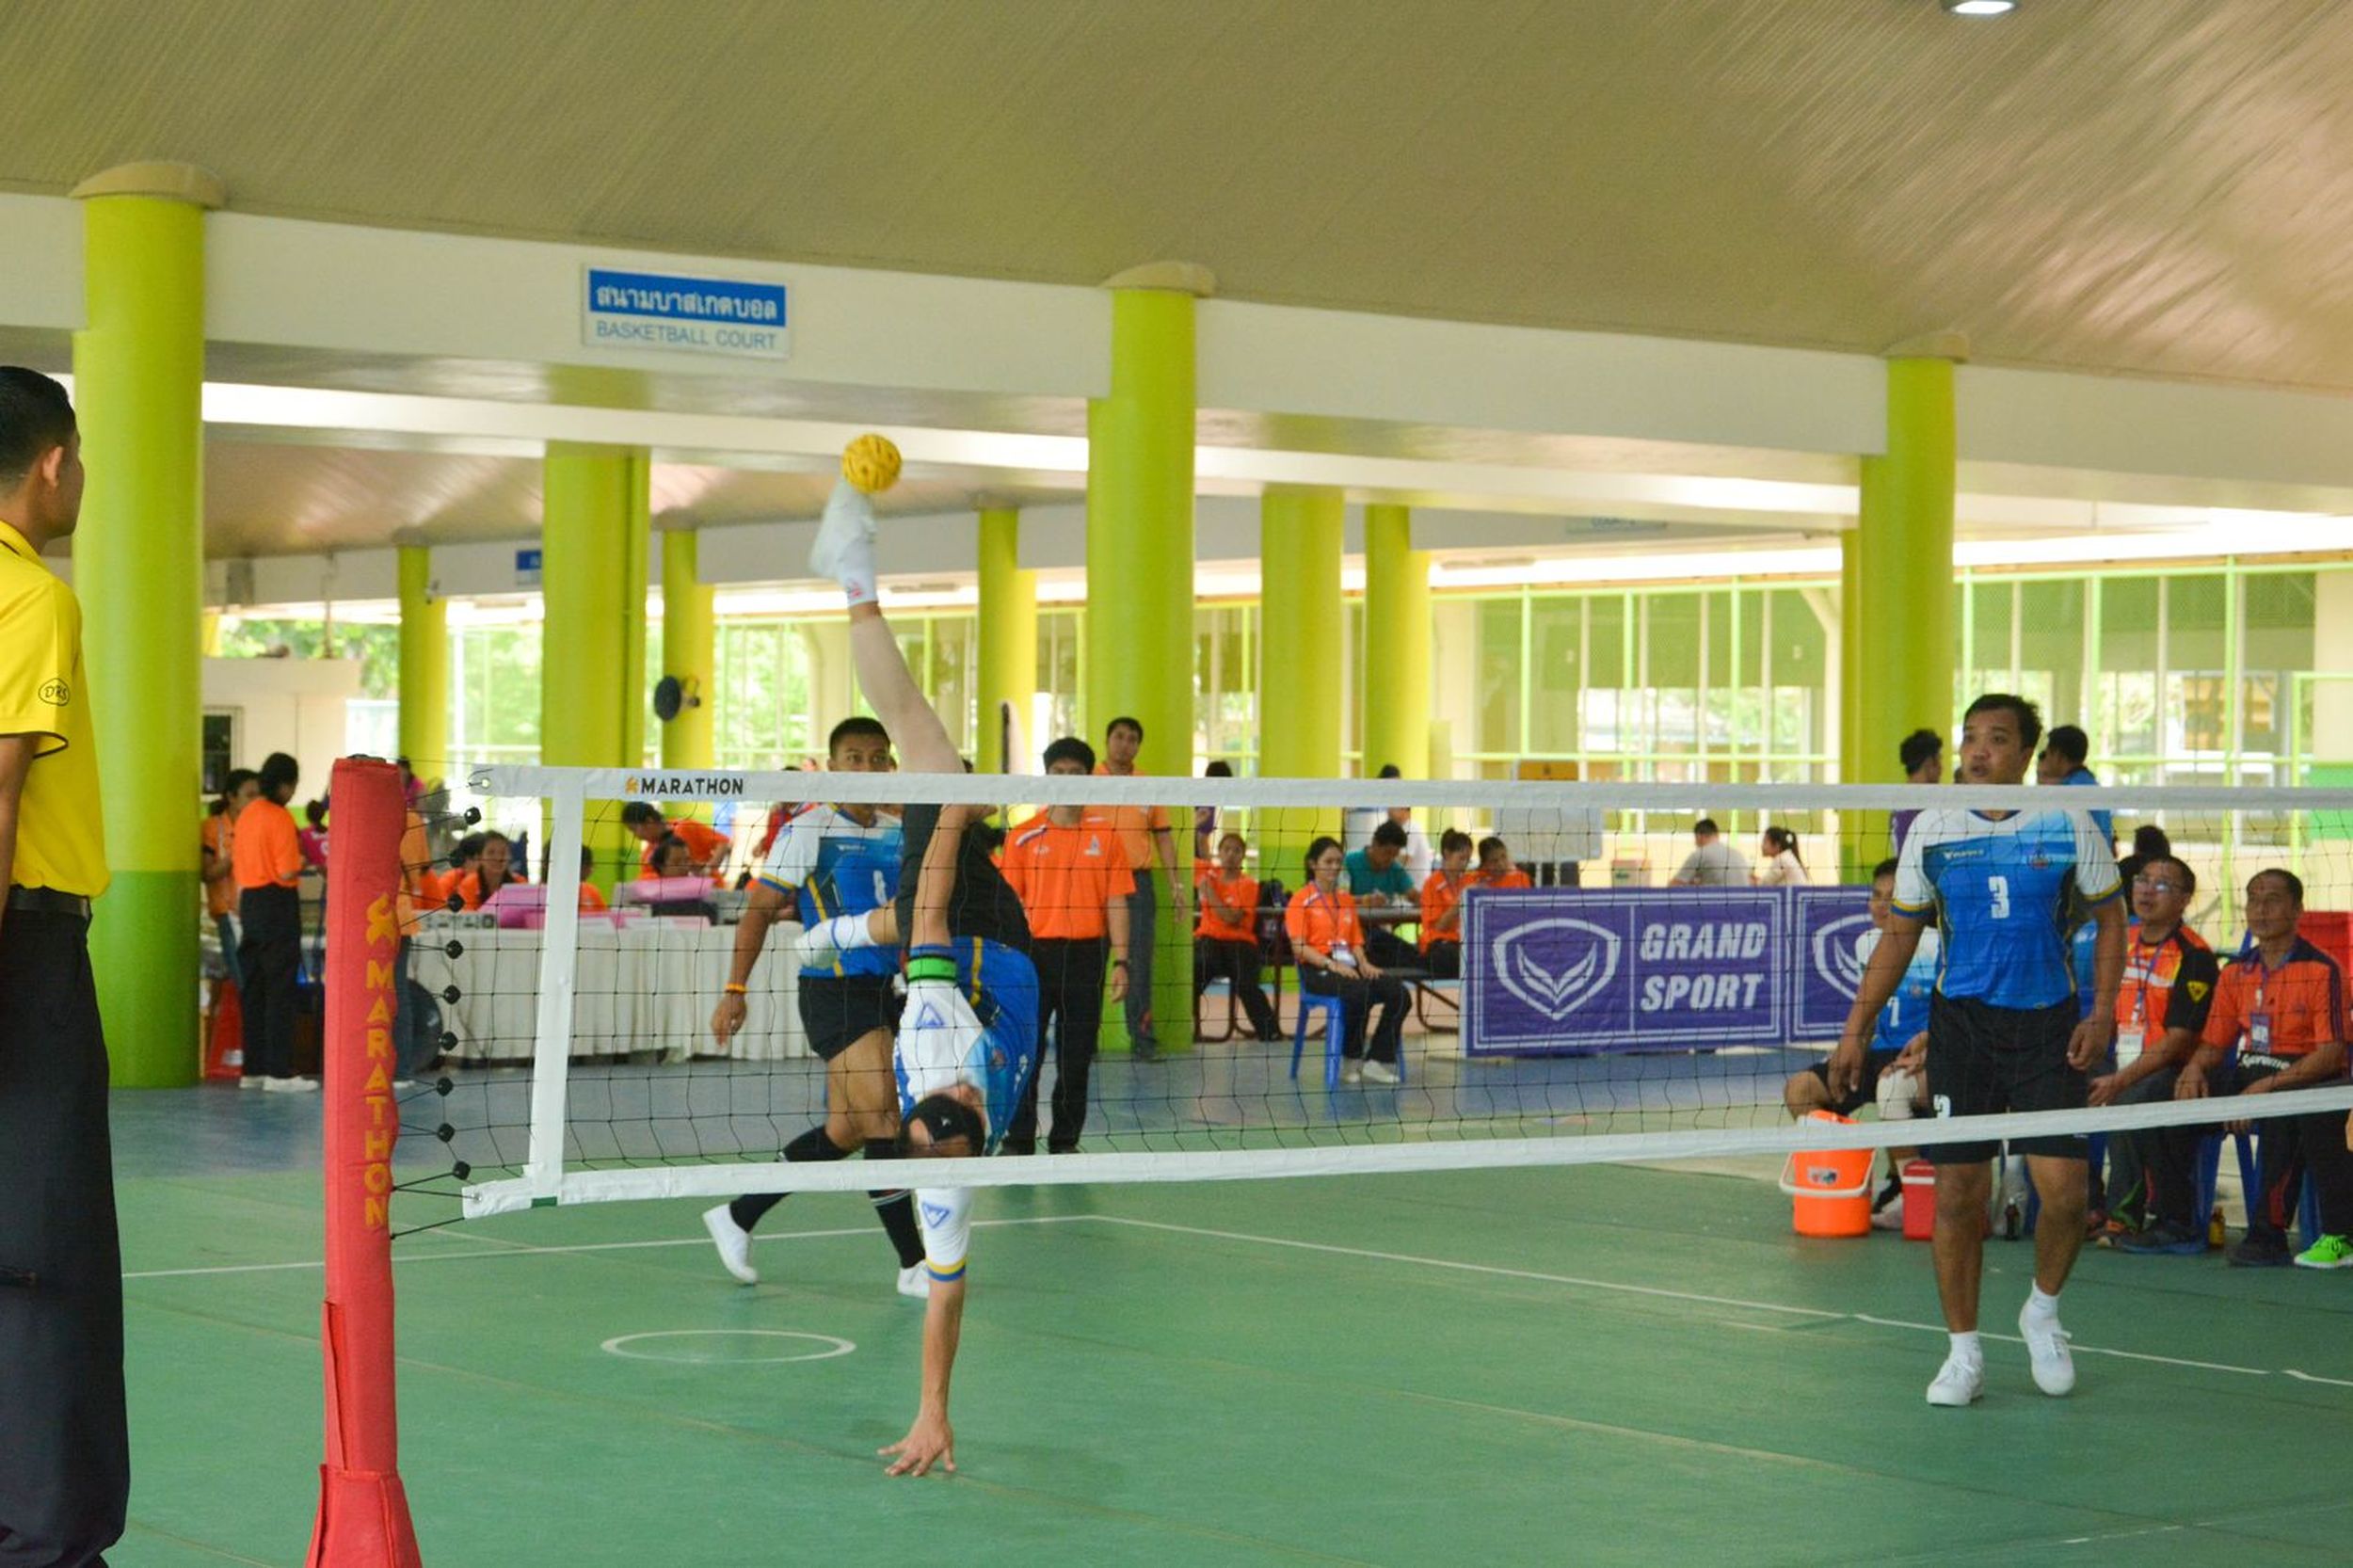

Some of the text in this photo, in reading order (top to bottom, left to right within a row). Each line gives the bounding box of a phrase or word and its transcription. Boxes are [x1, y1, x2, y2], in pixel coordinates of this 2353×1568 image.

[596, 320, 776, 349] BASKETBALL COURT
[640, 776, 744, 795] MARATHON
[1989, 875, 2009, 919] 3
[1640, 922, 1767, 961] GRAND
[1640, 972, 1765, 1012] SPORT
[364, 958, 394, 1228] MARATHON
